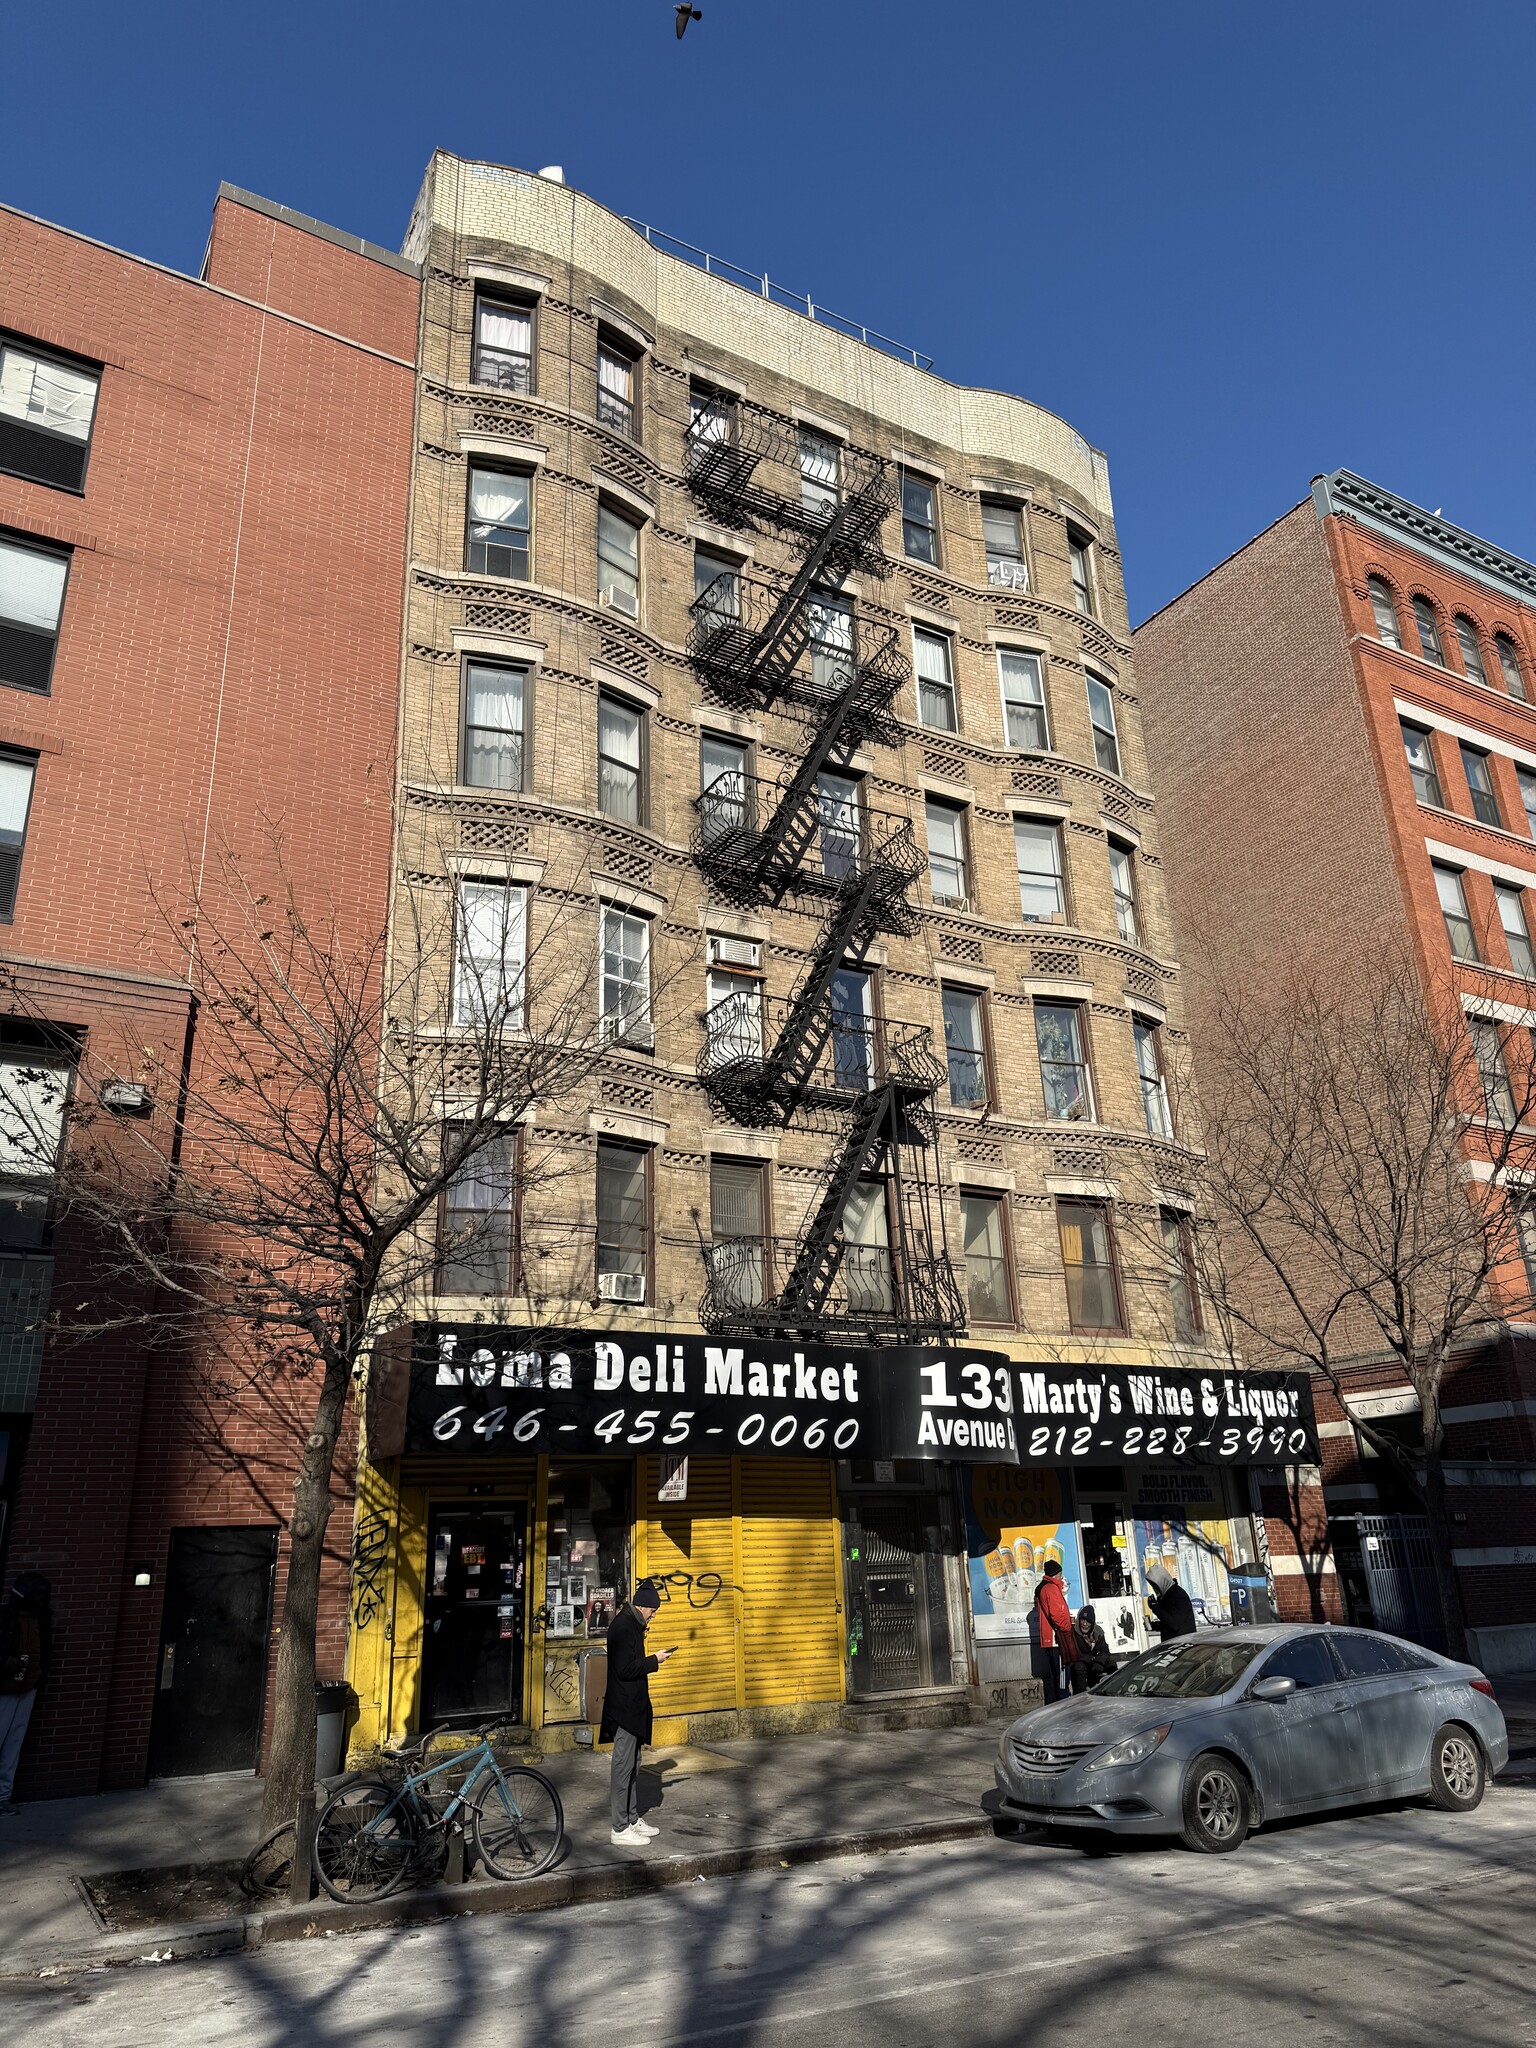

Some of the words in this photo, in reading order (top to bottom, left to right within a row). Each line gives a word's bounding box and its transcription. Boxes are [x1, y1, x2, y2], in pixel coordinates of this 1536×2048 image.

[435, 1333, 573, 1390] Loma
[593, 1341, 686, 1393] Deli
[704, 1347, 859, 1403] Market
[919, 1361, 1011, 1413] 133
[1019, 1372, 1122, 1424] Marty's
[1127, 1375, 1194, 1417] Wine
[1200, 1378, 1219, 1417] &
[1224, 1378, 1299, 1426] Liquor
[917, 1410, 1006, 1450] Avenue
[1028, 1425, 1306, 1455] 212-228-3990
[986, 1469, 1046, 1491] HIGH
[1142, 1474, 1167, 1488] BOLD
[1169, 1474, 1208, 1488] FLAVOR.
[983, 1497, 1054, 1519] NOON
[1138, 1488, 1180, 1503] SMOOTH
[1181, 1488, 1216, 1502] FINISH.
[463, 1553, 483, 1564] EBT
